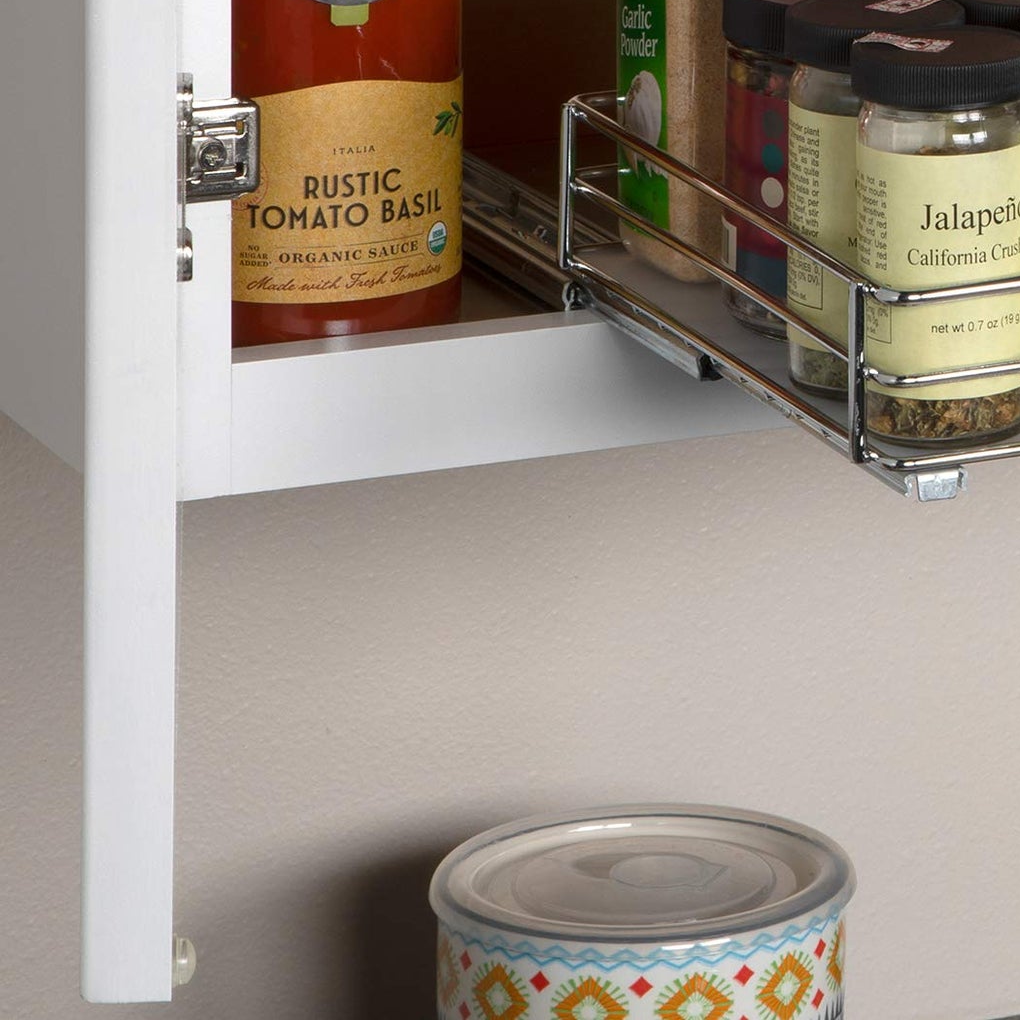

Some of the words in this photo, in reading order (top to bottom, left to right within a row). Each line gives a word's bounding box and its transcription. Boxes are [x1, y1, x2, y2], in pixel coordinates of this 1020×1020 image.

[621, 4, 653, 31] Garlic
[620, 31, 659, 59] Powder
[332, 145, 376, 156] ITALIA
[304, 167, 402, 200] RUSTIC
[247, 201, 369, 230] TOMATO
[381, 188, 442, 224] BASIL
[239, 252, 268, 260] SUGAR
[247, 244, 260, 252] NO
[278, 245, 362, 264] ORGANIC
[368, 240, 419, 259] SAUCE
[907, 246, 987, 267] California
[246, 275, 296, 292] Made
[300, 277, 340, 292] with
[345, 270, 388, 290] Fresh
[390, 263, 442, 283] Tomatoes
[931, 322, 948, 334] net
[952, 321, 965, 333] wt
[967, 320, 983, 332] 0.7
[986, 320, 999, 330] oz
